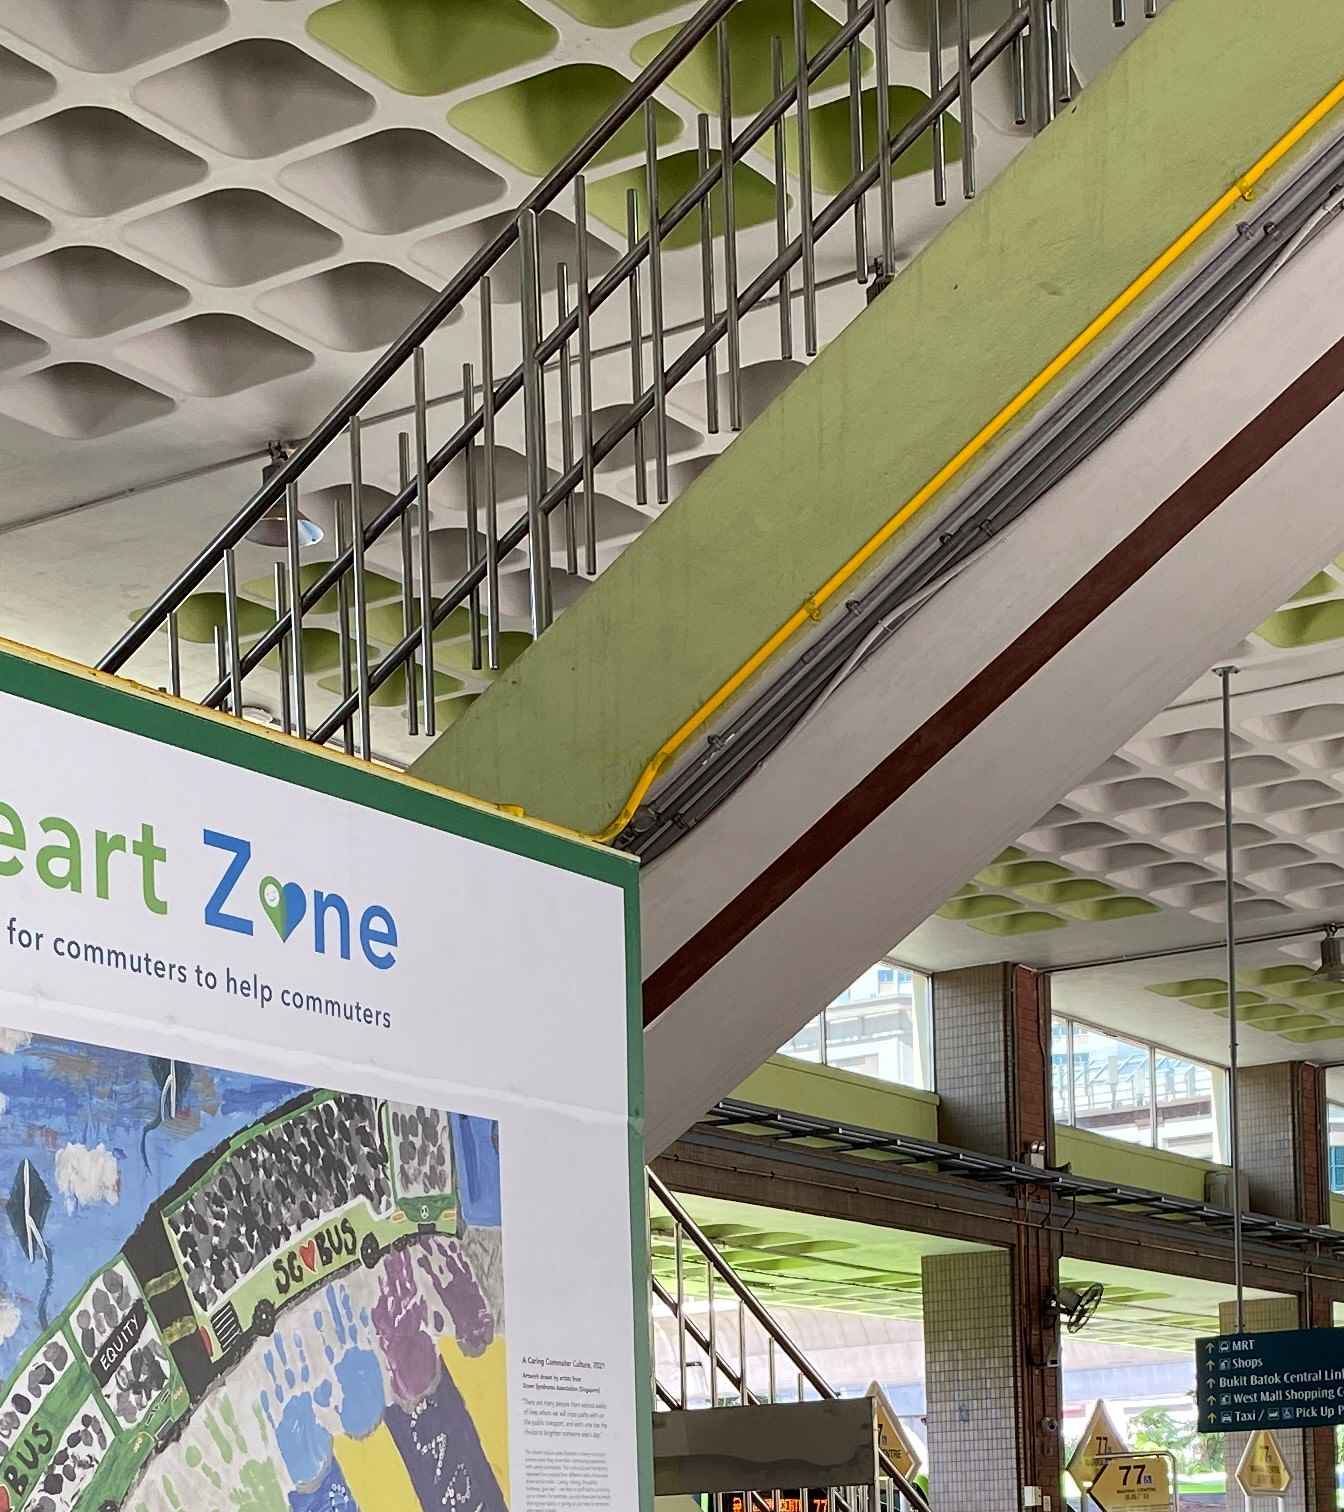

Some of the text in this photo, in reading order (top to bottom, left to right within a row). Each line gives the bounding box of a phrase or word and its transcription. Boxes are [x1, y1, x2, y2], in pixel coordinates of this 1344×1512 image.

[6, 916, 45, 952] for
[52, 935, 188, 985] commuters
[194, 964, 218, 991] to
[225, 966, 273, 1005] help
[280, 986, 392, 1029] commuters
[272, 1216, 356, 1294] SG BUS
[97, 1312, 141, 1371] EQUITY
[1232, 1339, 1256, 1351] MRT
[1232, 1357, 1264, 1370] Shops
[1219, 1375, 1248, 1388] Bukit
[1250, 1372, 1282, 1386] Batok
[1283, 1370, 1322, 1384] Central
[1233, 1392, 1258, 1404] West
[1260, 1389, 1283, 1402] Mall
[1285, 1386, 1335, 1403] Shopping
[1234, 1410, 1257, 1423] Taxi
[1296, 1407, 1318, 1419] Pick
[1320, 1405, 1335, 1418] Up
[1095, 1436, 1109, 1455] 77
[3, 1420, 54, 1496] BUS
[1119, 1464, 1146, 1486] 77
